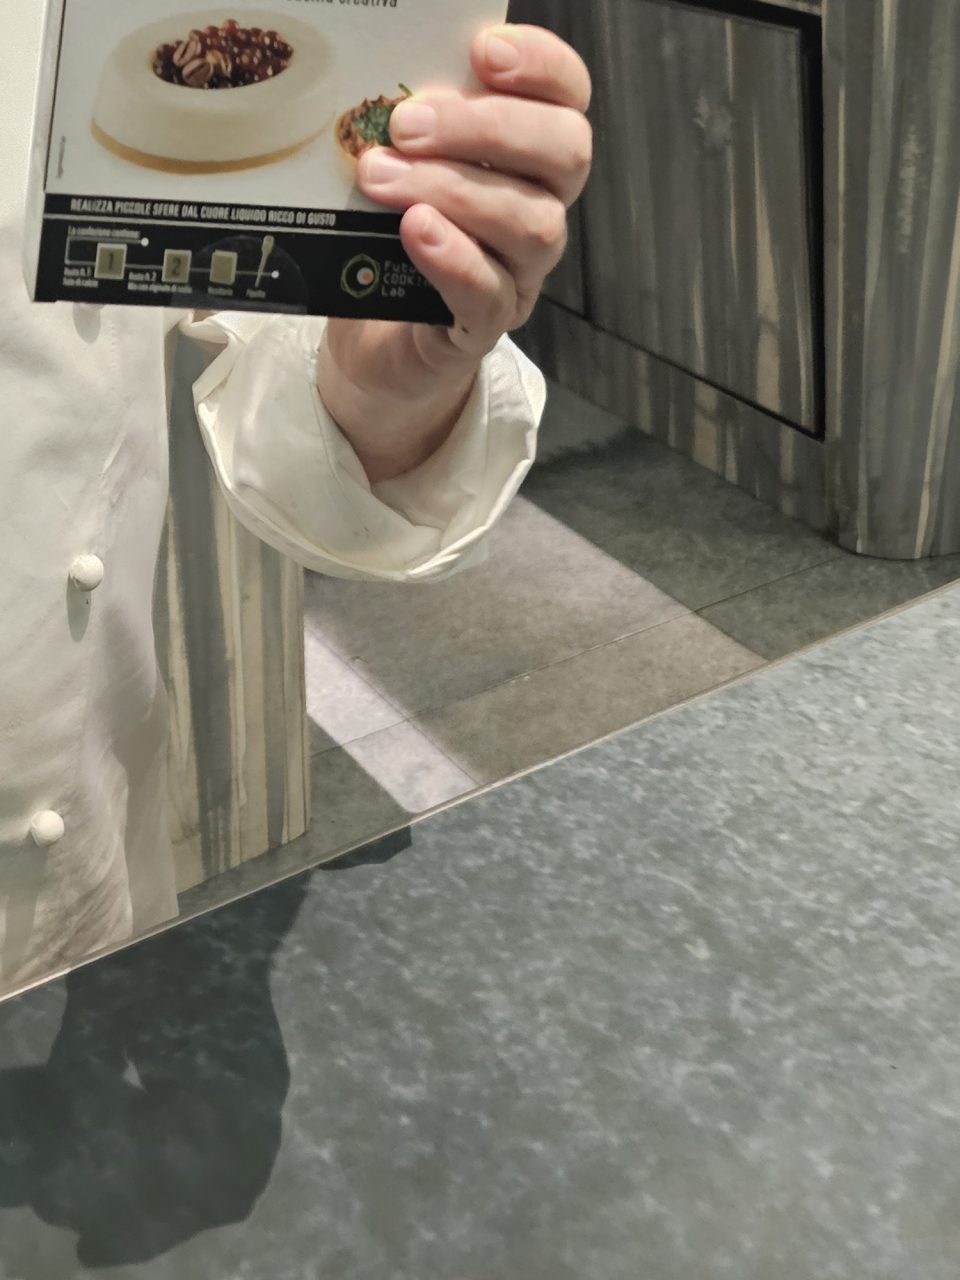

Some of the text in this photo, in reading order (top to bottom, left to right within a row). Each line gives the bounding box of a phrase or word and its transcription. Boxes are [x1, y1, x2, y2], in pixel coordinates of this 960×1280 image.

[181, 204, 198, 218] DAL
[107, 251, 115, 271] 1
[171, 256, 183, 277] 2
